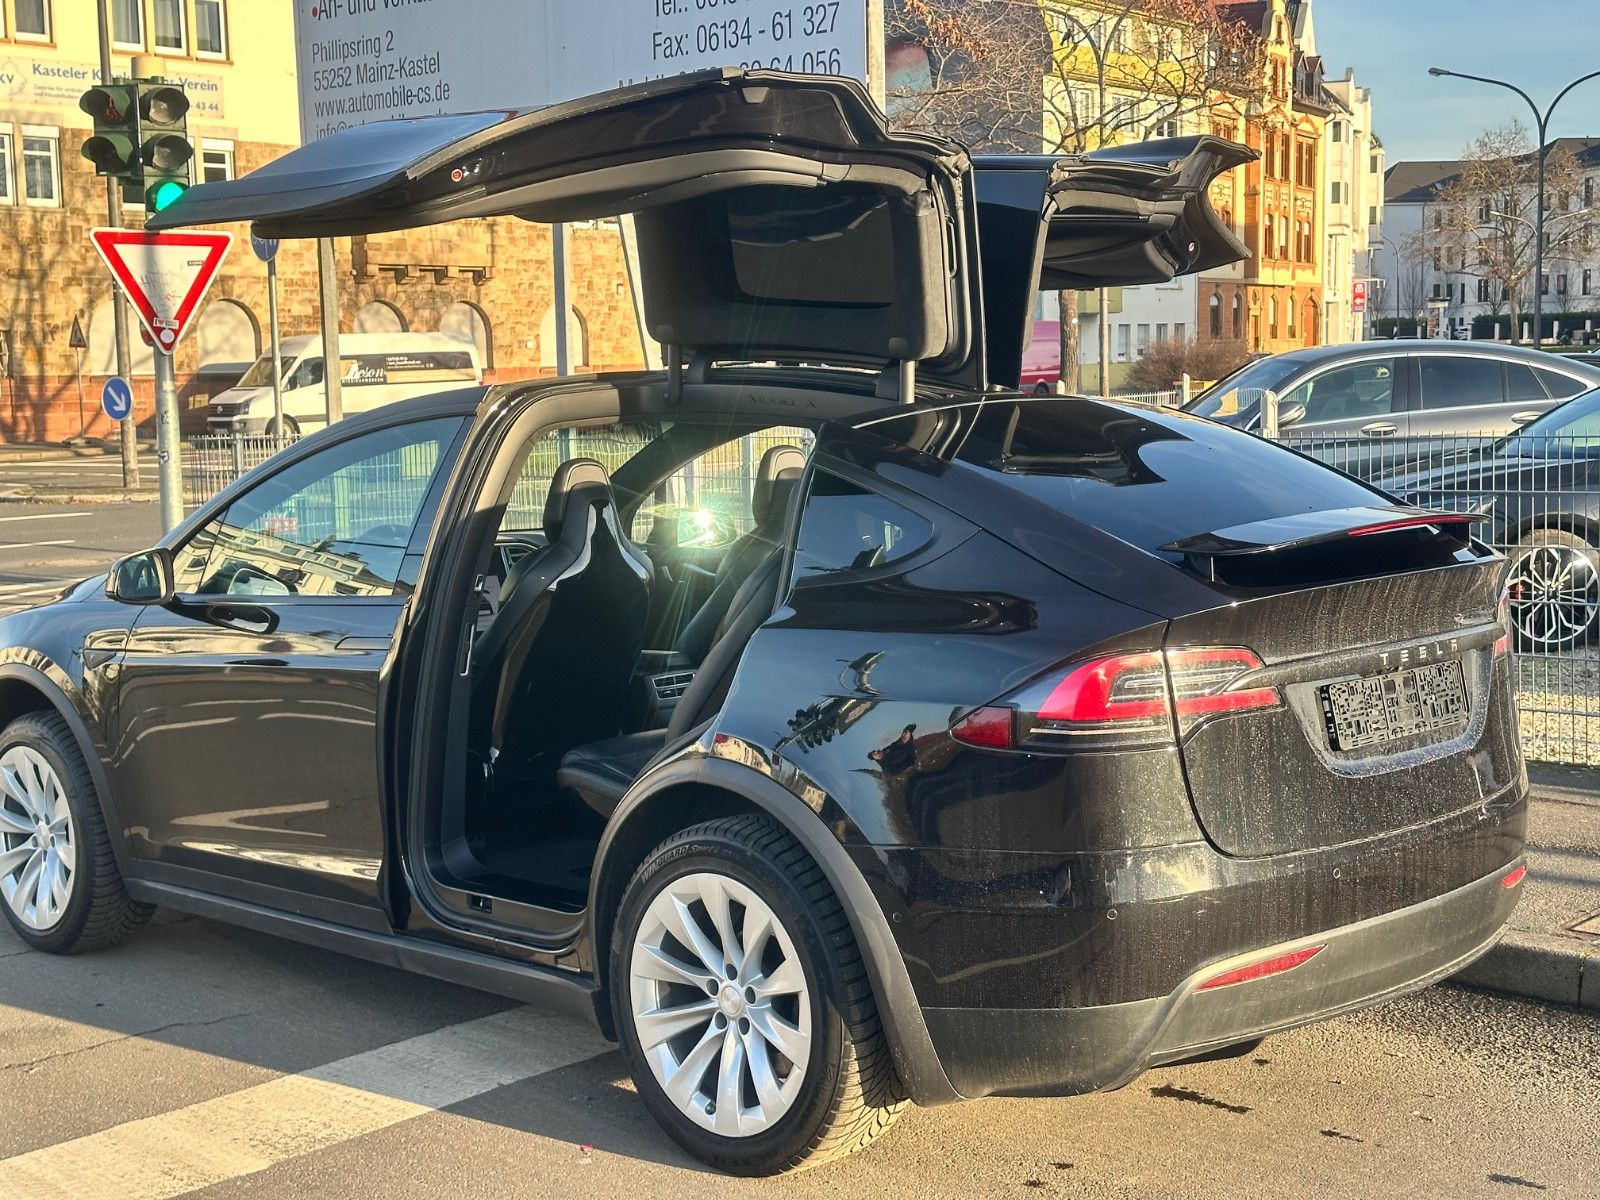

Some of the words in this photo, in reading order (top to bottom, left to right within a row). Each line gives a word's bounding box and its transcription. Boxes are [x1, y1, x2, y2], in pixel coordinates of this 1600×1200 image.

[653, 31, 689, 60] Fax:
[696, 16, 752, 53] 06134
[772, 9, 792, 41] 61
[803, 1, 840, 36] 327
[312, 35, 381, 63] Phillipsring
[386, 30, 394, 51] 2
[802, 47, 841, 75] 056
[33, 63, 88, 79] Kasteler
[314, 66, 352, 91] 55252
[356, 51, 440, 85] Mainz-Kastel
[195, 102, 206, 110] 43
[208, 103, 219, 111] 44
[314, 79, 450, 118] www.automobile-cs.de
[1379, 639, 1459, 666] TESLA
